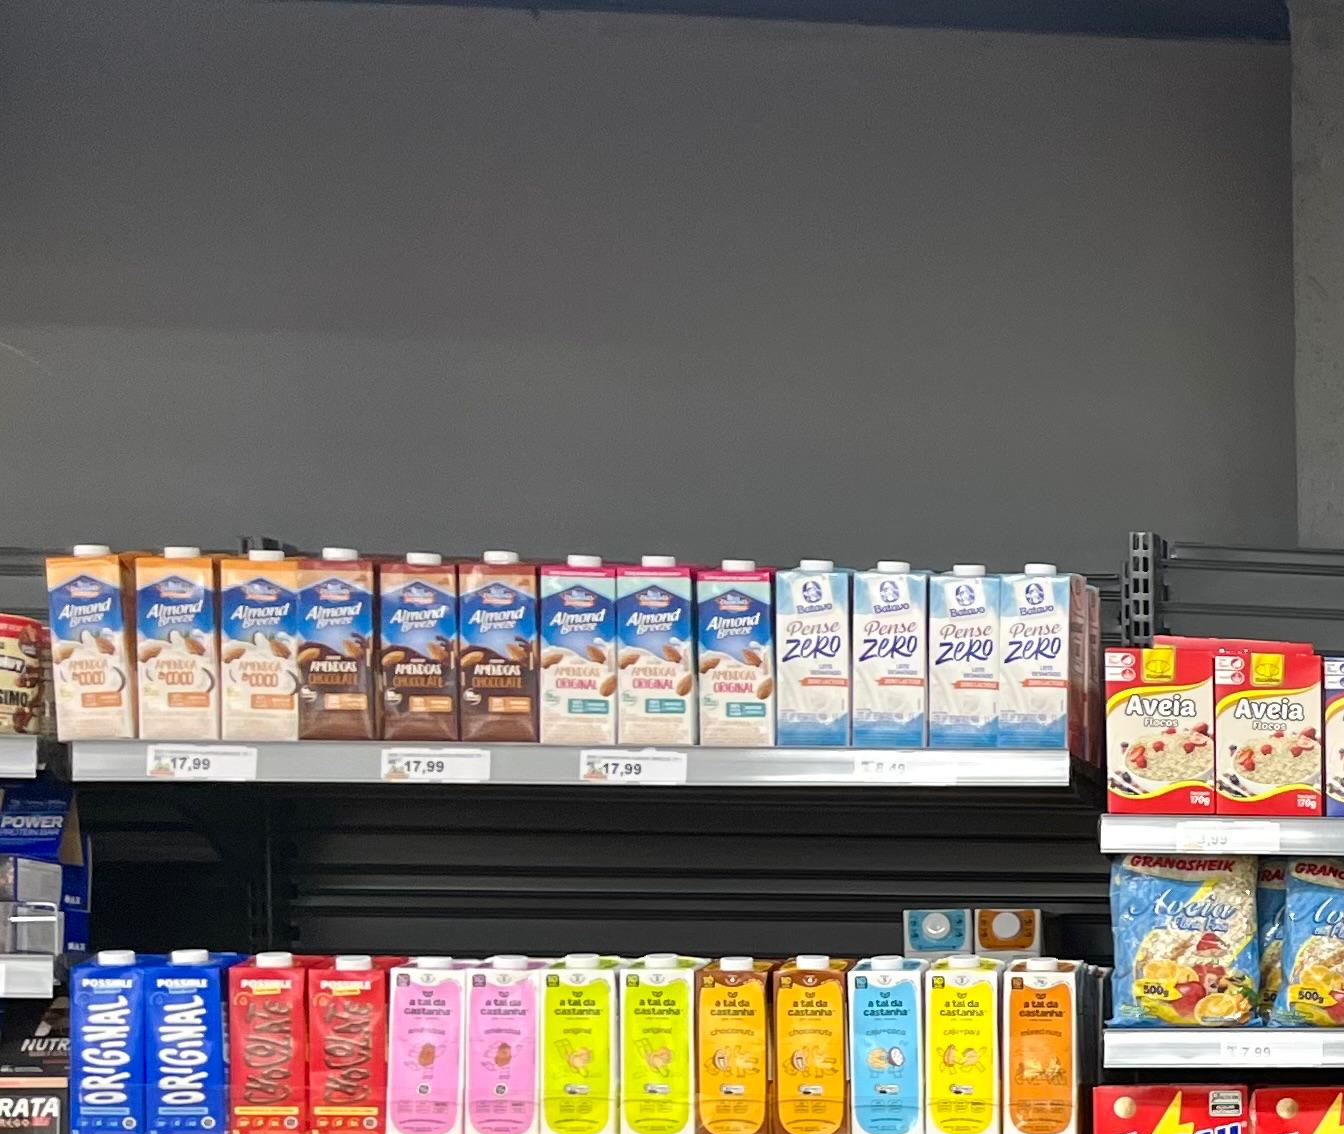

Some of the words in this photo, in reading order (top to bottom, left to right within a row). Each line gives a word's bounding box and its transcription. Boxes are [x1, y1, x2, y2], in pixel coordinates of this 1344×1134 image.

[58, 599, 111, 622] Almond
[70, 613, 103, 629] Breeze
[706, 612, 760, 630] Almond
[717, 624, 752, 639] Breeze
[787, 618, 841, 641] Pense
[1009, 621, 1061, 641] Pense
[712, 680, 753, 694] ORIGINAL
[1126, 695, 1195, 717] Aveia
[1234, 698, 1303, 721] Aveia
[1144, 717, 1178, 727] Flocos
[170, 757, 210, 771] 17,99
[403, 760, 444, 773] 17,99
[602, 762, 642, 776] 17,99
[1, 816, 63, 828] POWER
[1130, 856, 1235, 874] GRANOSHEIK
[82, 978, 132, 989] POSSIBLE
[240, 979, 291, 990] POSSIBLE
[1143, 984, 1169, 996] 500g
[81, 996, 132, 1105] ORIGINAL
[158, 996, 206, 1105] ORIGINAL
